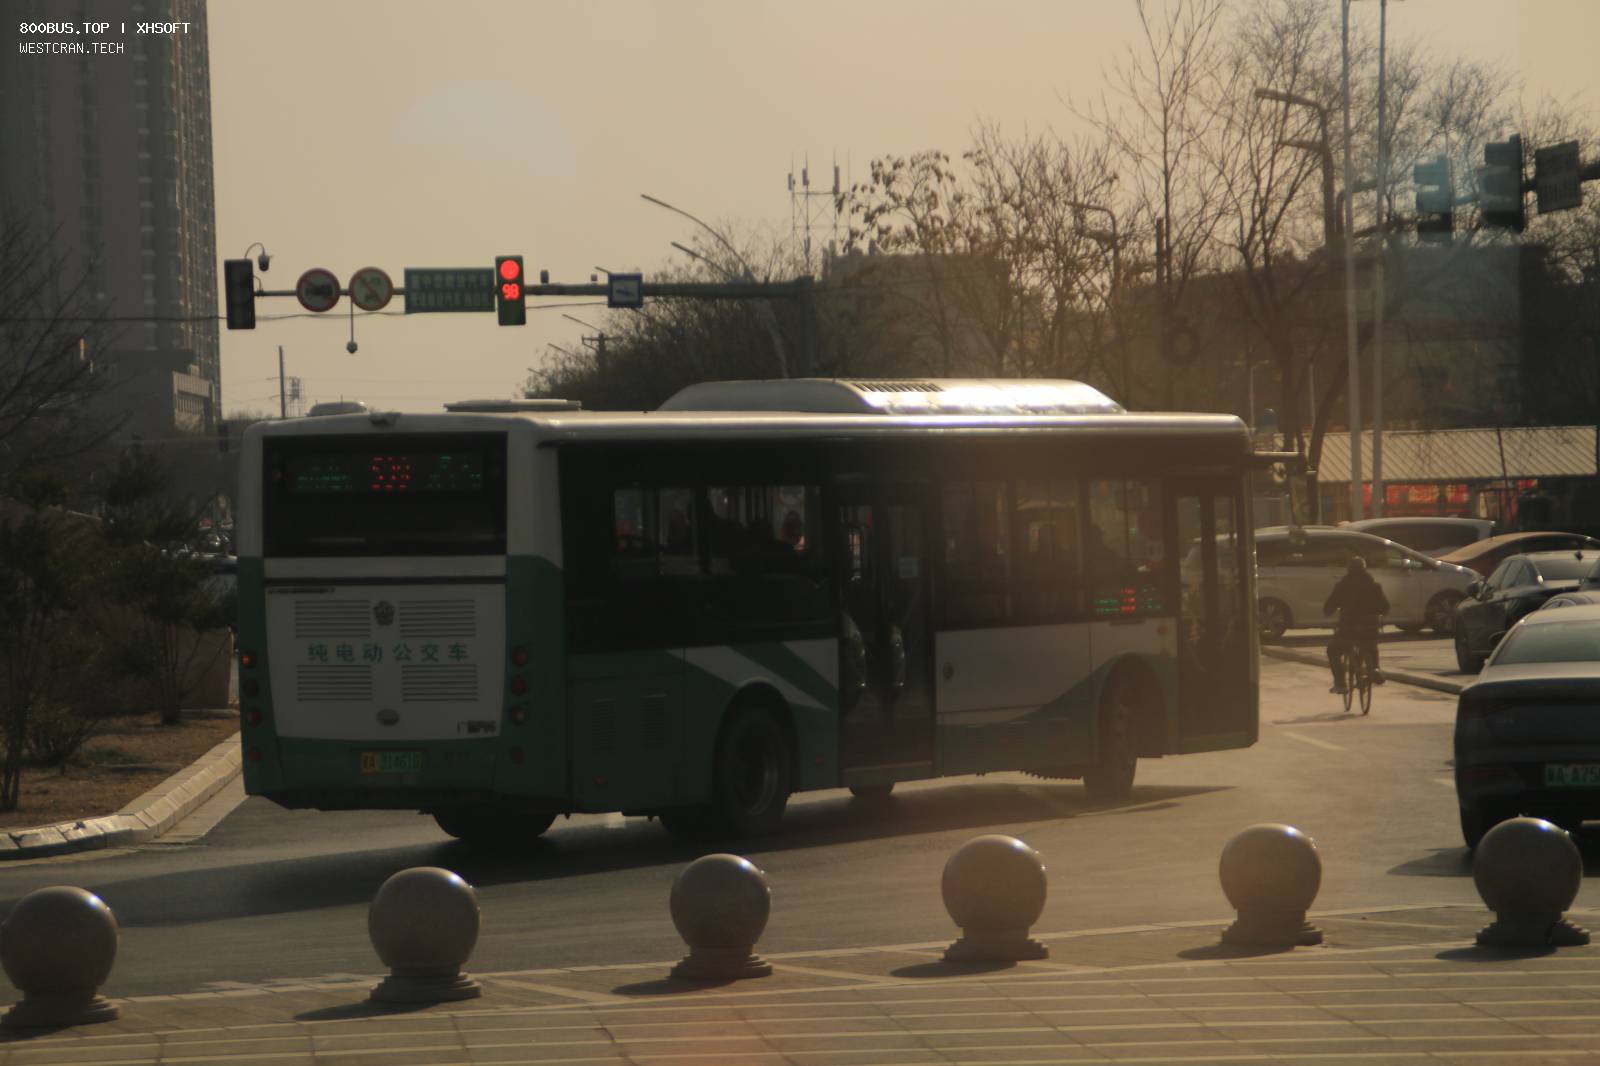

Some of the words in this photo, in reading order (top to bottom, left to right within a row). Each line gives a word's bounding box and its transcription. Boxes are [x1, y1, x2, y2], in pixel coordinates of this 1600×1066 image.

[501, 282, 520, 300] 98
[306, 641, 469, 663] 纯电动公交车
